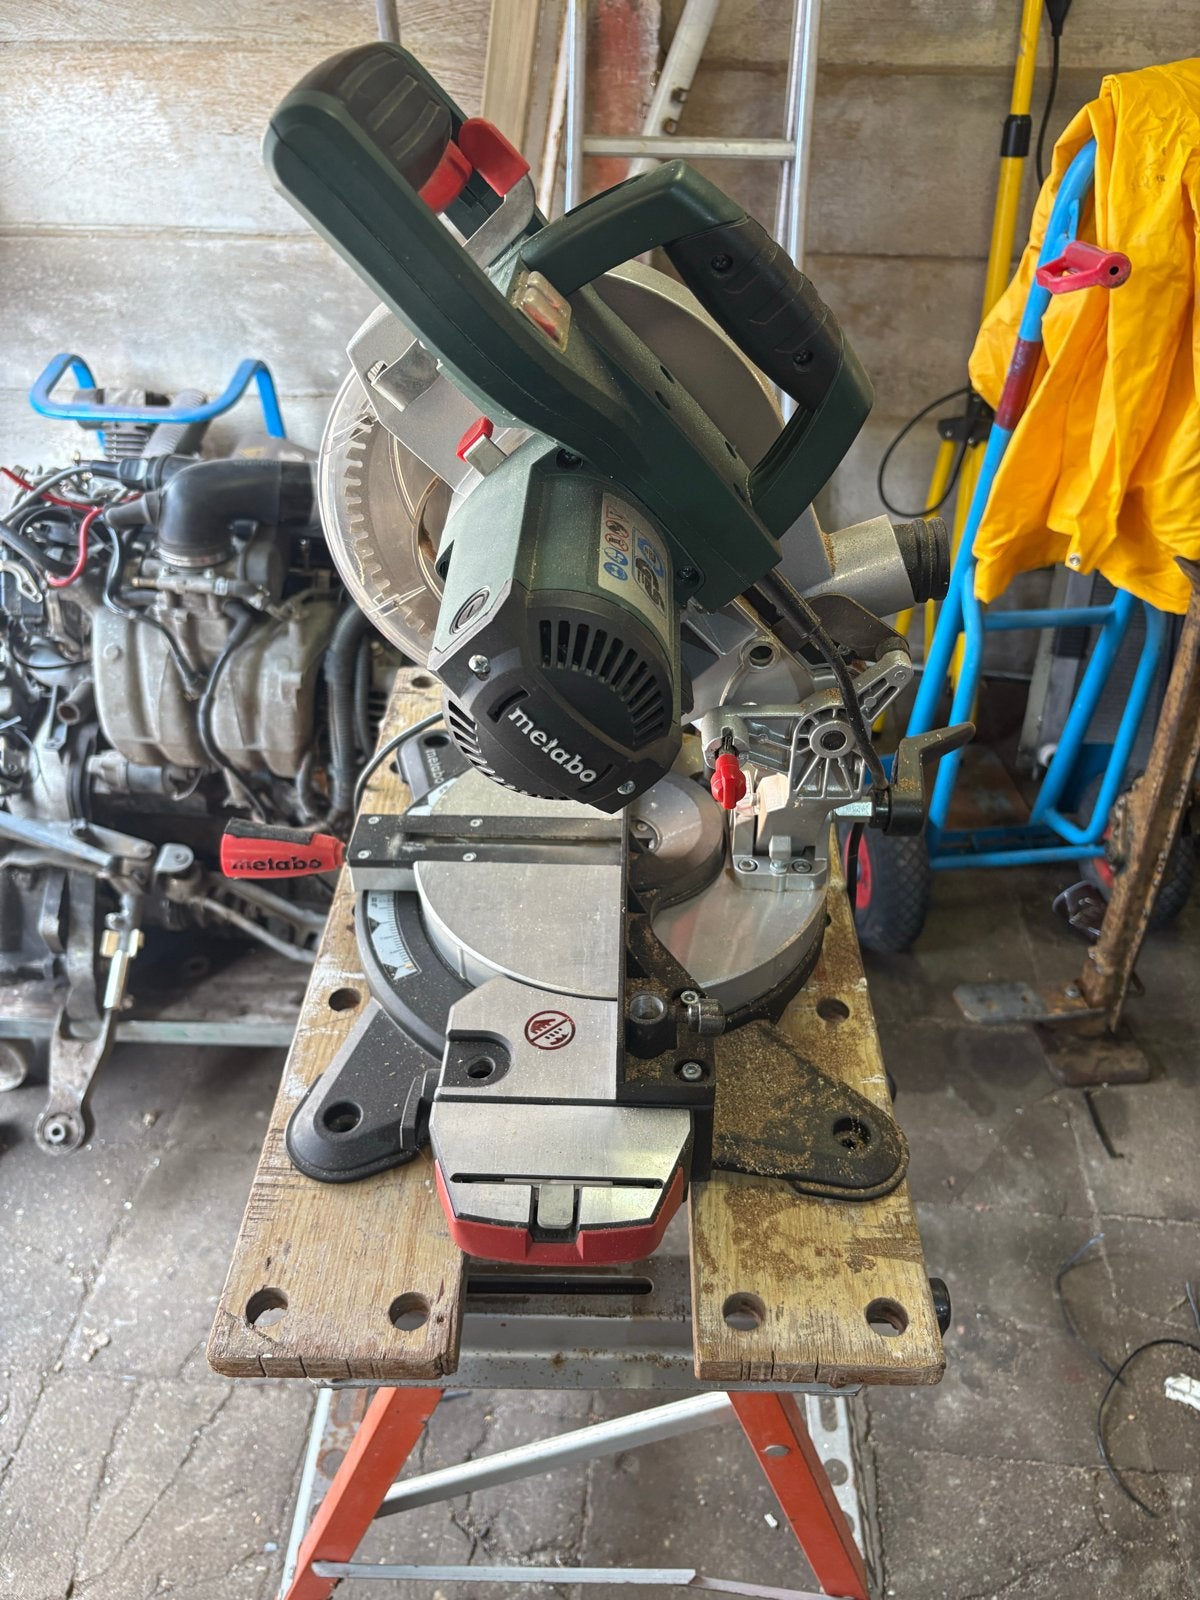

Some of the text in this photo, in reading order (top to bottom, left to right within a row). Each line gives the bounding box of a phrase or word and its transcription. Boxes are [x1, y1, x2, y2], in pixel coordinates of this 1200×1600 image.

[508, 706, 597, 783] metabo
[425, 748, 445, 784] metabo
[232, 857, 322, 871] metabo
